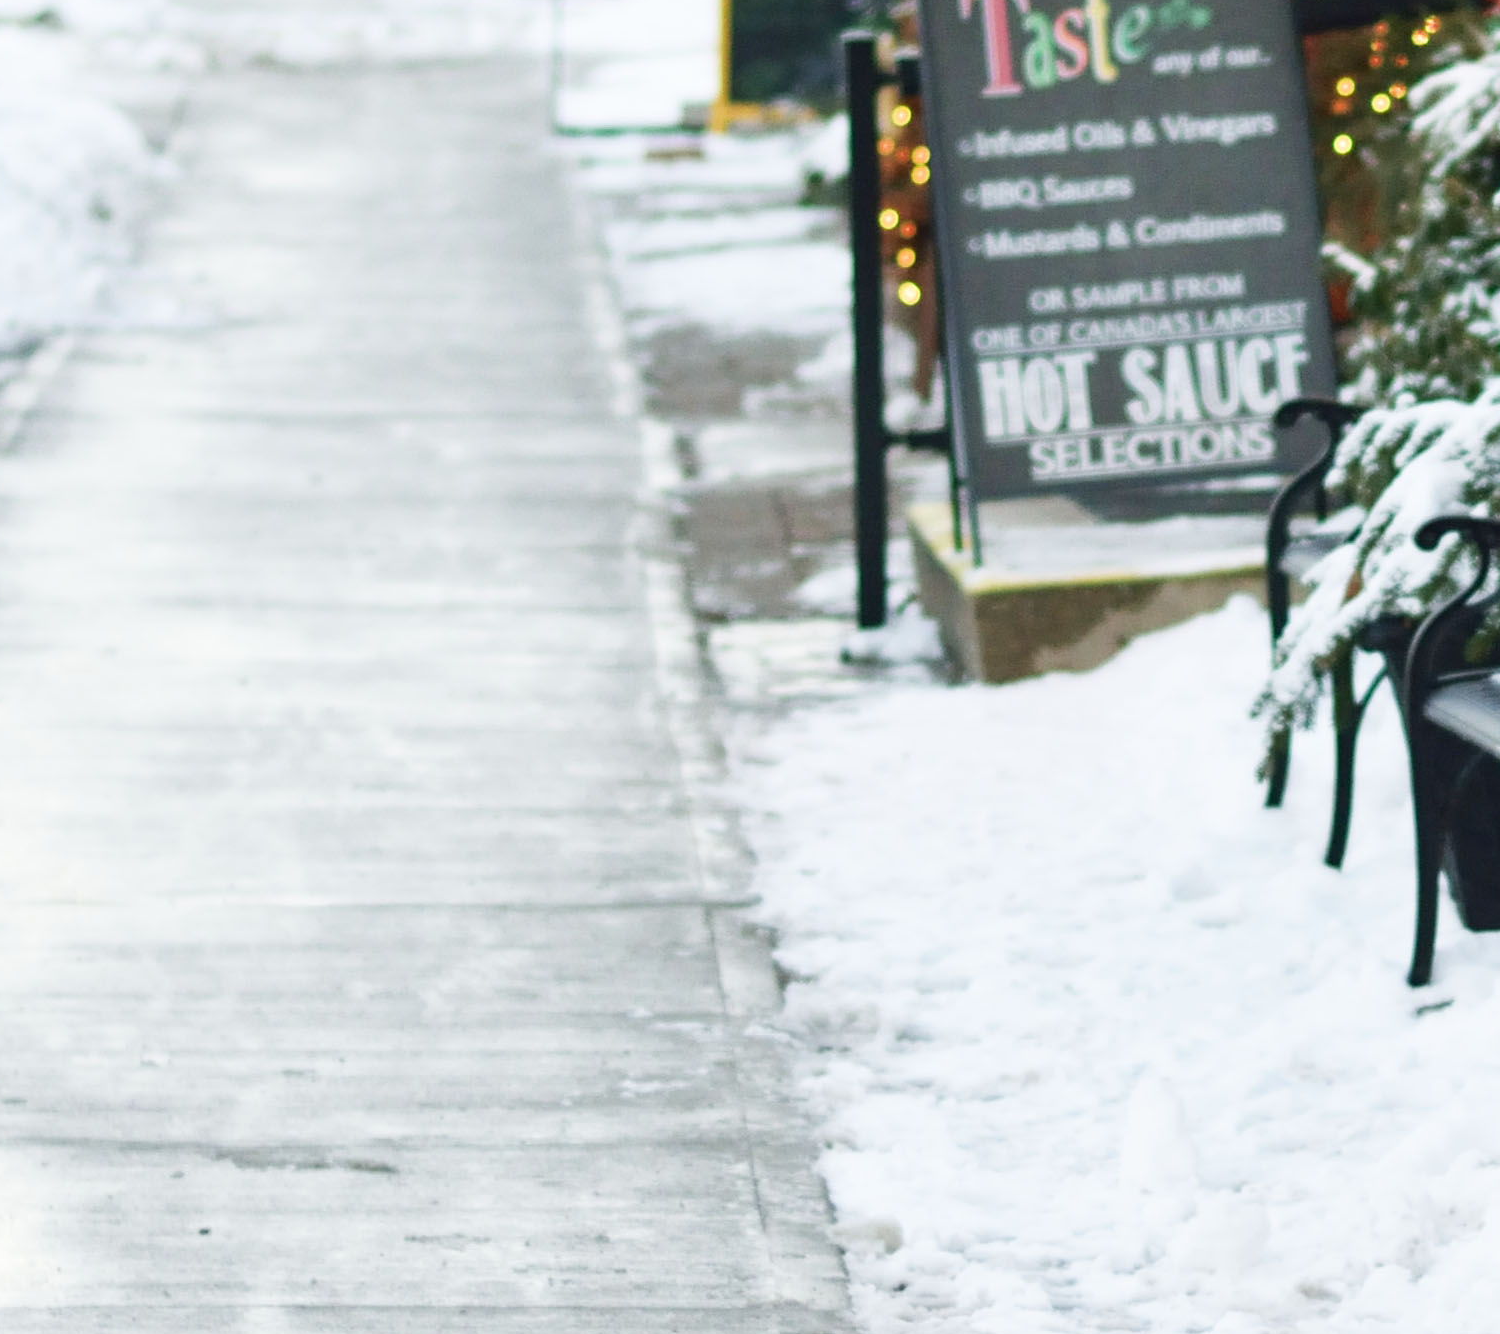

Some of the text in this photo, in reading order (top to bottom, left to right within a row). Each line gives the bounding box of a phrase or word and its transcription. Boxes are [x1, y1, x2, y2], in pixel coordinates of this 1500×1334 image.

[1153, 51, 1193, 76] any
[1199, 45, 1222, 67] of
[975, 113, 1277, 157] Infused Oils & Vinegars
[979, 175, 1134, 210] BBQ Sauces
[984, 211, 1285, 259] Mustards & Condiments
[1029, 271, 1245, 314] OR SAMPLE FROM
[972, 324, 1022, 351] ONE
[1029, 322, 1062, 347] OF
[1198, 300, 1307, 332] LARGEST
[977, 350, 1097, 442] HOT
[1029, 421, 1275, 471] SELECTIONS
